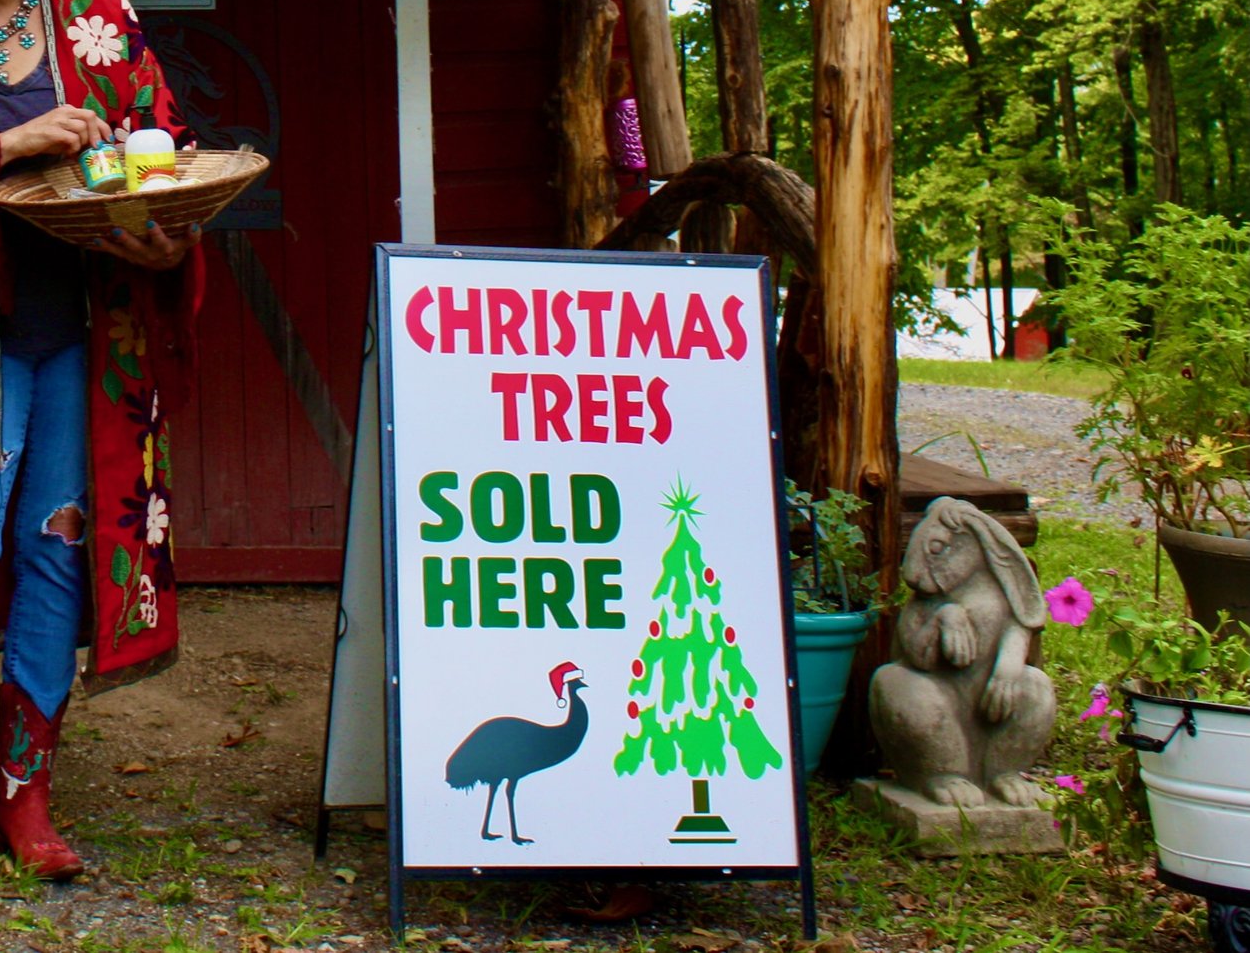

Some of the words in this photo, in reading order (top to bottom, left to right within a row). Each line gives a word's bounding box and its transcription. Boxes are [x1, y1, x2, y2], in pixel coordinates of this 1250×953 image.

[405, 285, 748, 361] CHRISTMAS
[490, 372, 673, 445] TREES
[418, 470, 622, 544] SOLD
[422, 555, 626, 630] HERE
